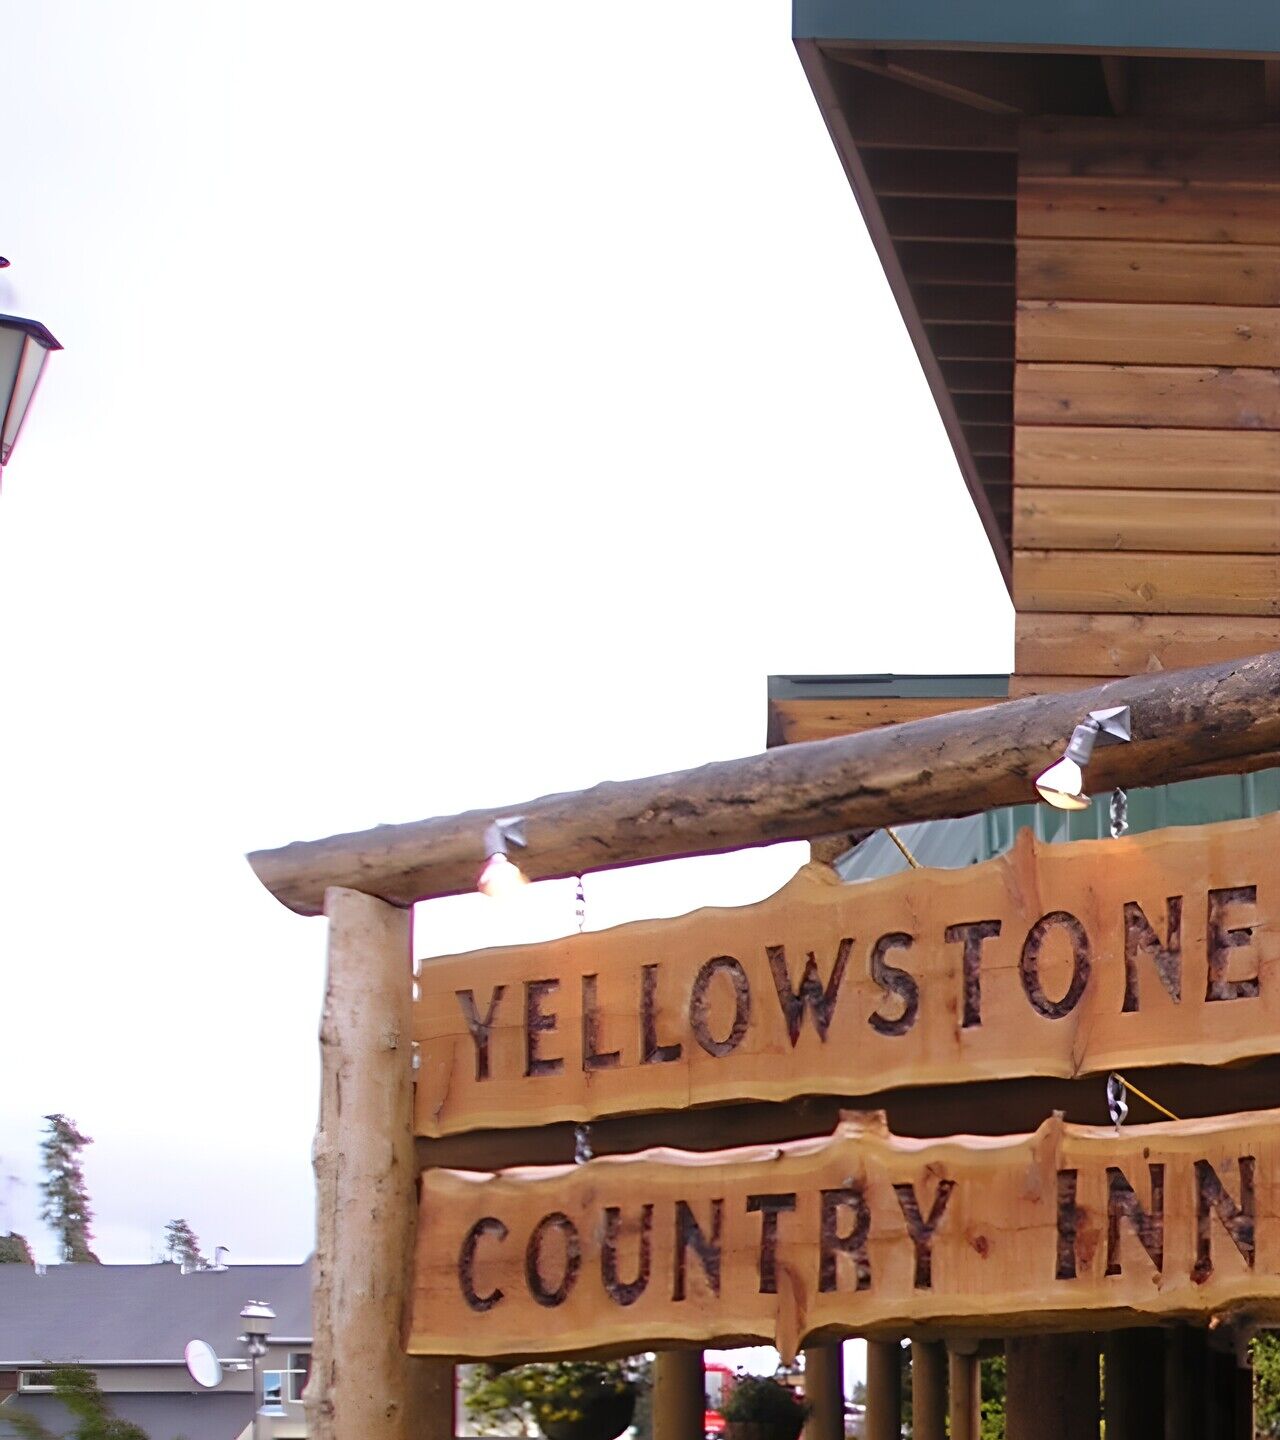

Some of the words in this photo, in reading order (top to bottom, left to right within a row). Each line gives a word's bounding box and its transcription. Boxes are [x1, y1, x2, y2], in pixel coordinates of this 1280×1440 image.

[455, 885, 1261, 1081] YELLOWSTONE
[460, 1180, 956, 1312] COUNTRY
[1055, 1155, 1257, 1285] INN
